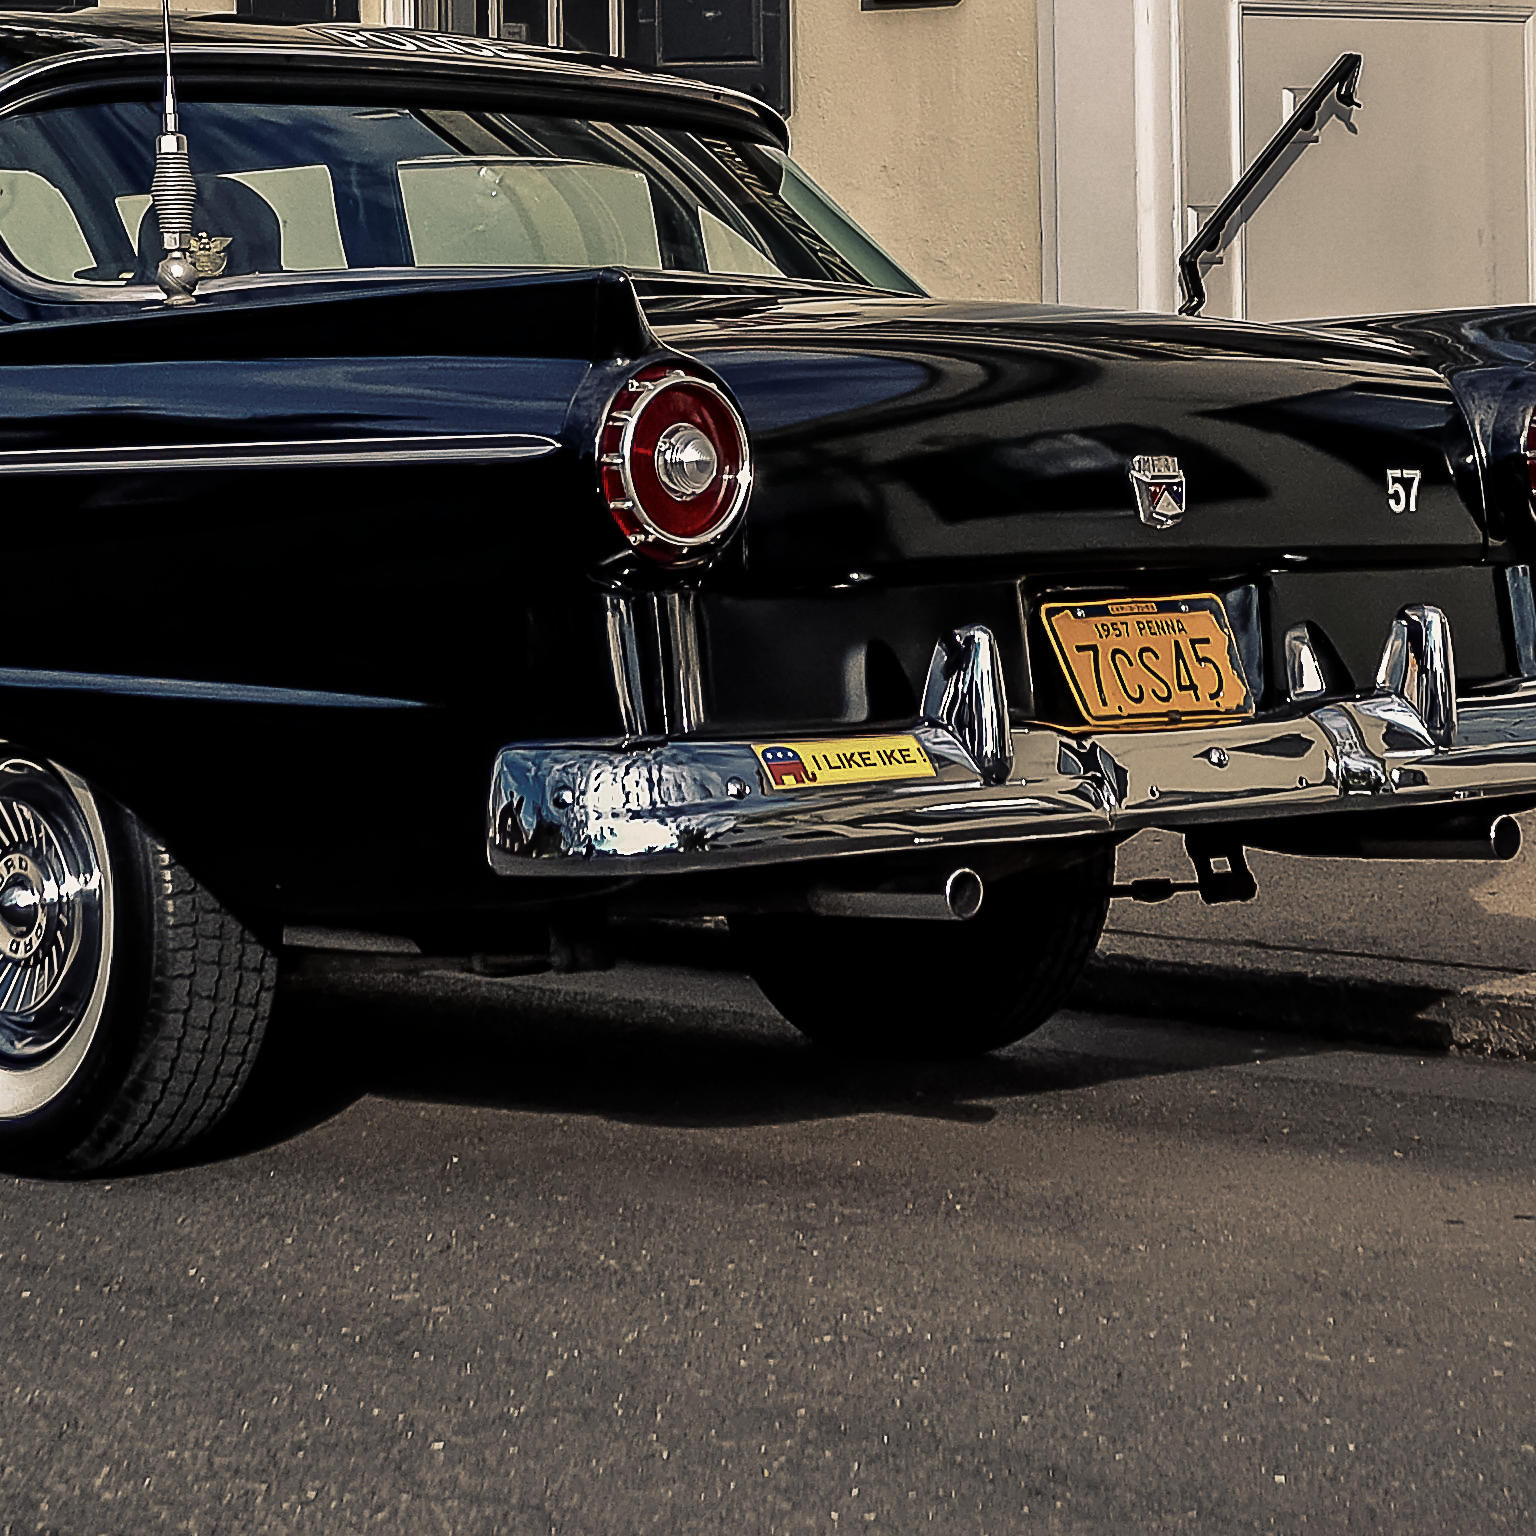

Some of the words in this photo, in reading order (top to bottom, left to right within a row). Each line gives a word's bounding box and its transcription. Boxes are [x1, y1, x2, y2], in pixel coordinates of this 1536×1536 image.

[321, 28, 529, 60] POLICE
[1386, 468, 1421, 513] 57
[1094, 621, 1131, 639] 1957
[1135, 618, 1188, 637] PENNA
[1074, 636, 1224, 708] 7CS45
[811, 754, 822, 771] I
[822, 750, 877, 771] LIKE
